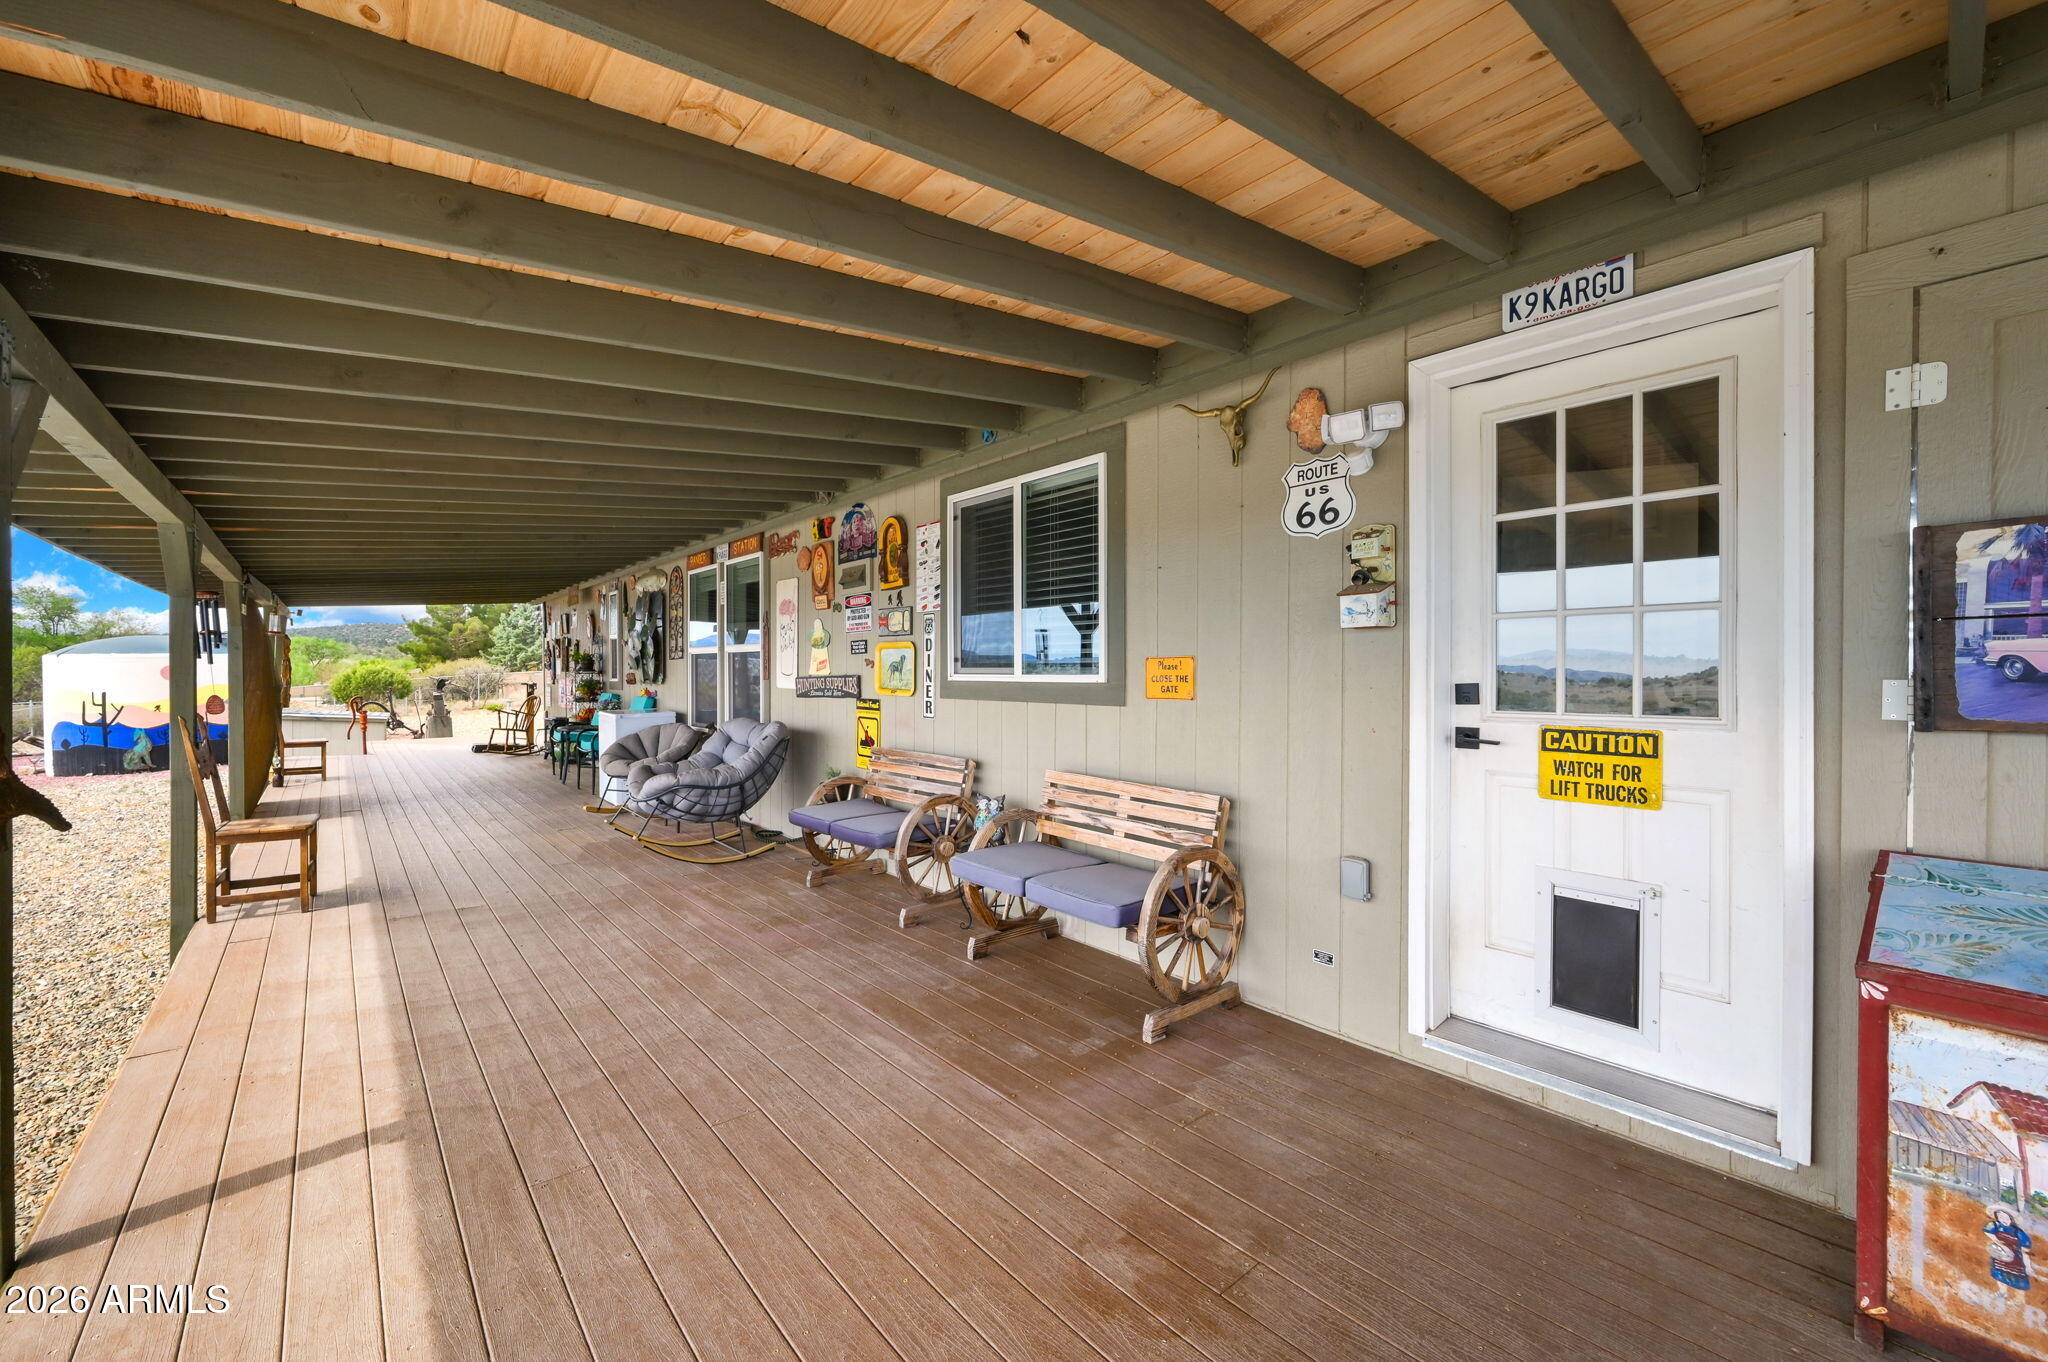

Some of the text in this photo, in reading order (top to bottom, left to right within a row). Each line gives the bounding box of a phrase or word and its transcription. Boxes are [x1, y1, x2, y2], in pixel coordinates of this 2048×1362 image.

[1509, 266, 1624, 323] K9KARGO
[1533, 301, 1599, 322] dmv.ca.gov
[1297, 462, 1339, 483] ROUTE
[1305, 485, 1330, 497] US
[1296, 497, 1340, 529] 66
[733, 537, 757, 555] STATION
[796, 677, 858, 695] HUNTING SUPPLIES
[925, 638, 933, 714] DINER
[1176, 675, 1189, 683] THE
[1160, 685, 1179, 693] GATE
[1545, 731, 1653, 755] CAUTION
[1553, 759, 1642, 782] WATCH FOR
[1550, 779, 1648, 804] LIFT TRUCKS
